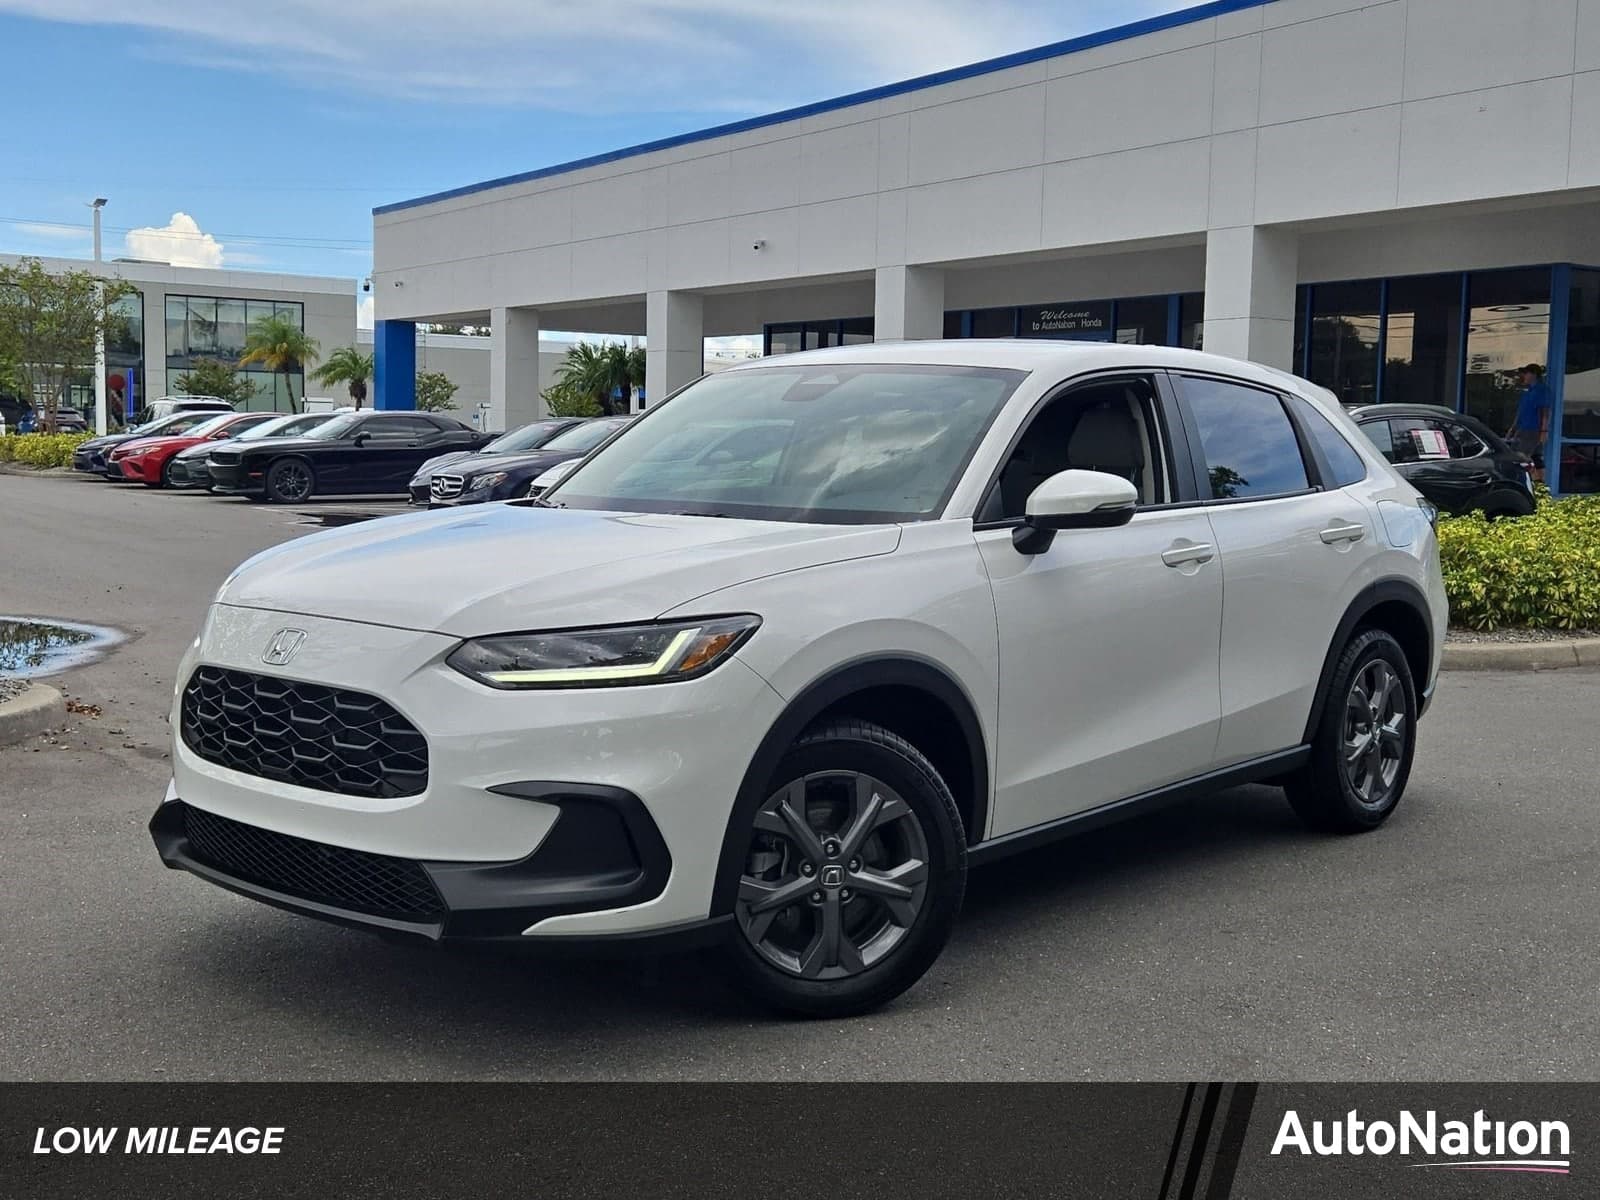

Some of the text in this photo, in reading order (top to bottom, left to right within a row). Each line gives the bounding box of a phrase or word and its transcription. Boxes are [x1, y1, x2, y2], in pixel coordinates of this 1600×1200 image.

[1040, 310, 1090, 320] Welcome
[1032, 318, 1102, 331] to AutoNation Honda
